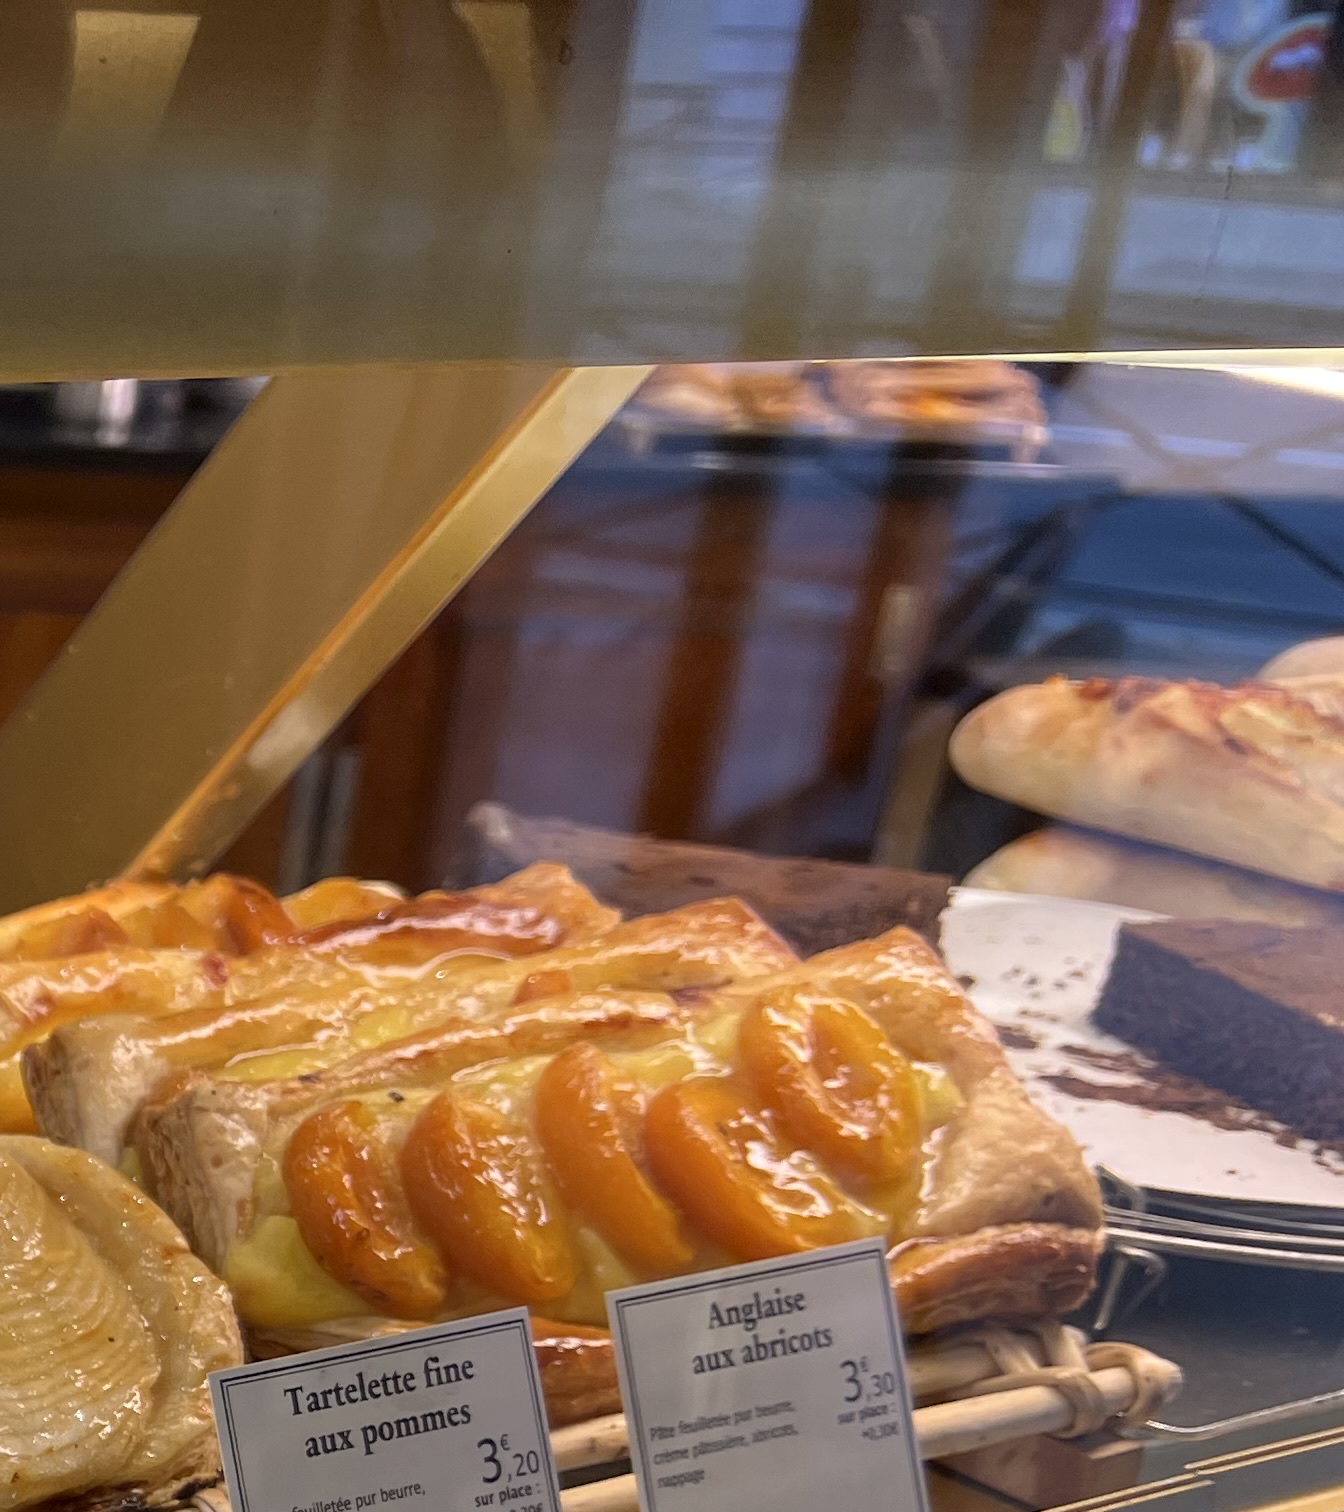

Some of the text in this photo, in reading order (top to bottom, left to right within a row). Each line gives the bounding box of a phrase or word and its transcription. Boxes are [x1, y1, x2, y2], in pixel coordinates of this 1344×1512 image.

[708, 1287, 807, 1332] Anglaise
[692, 1328, 833, 1375] aux abricots
[283, 1356, 475, 1416] Tartelette fine
[304, 1404, 471, 1458] aux pommes
[355, 1492, 377, 1512] pur
[379, 1483, 426, 1503] beurre,
[474, 1493, 495, 1508] sur
[498, 1484, 533, 1506] place
